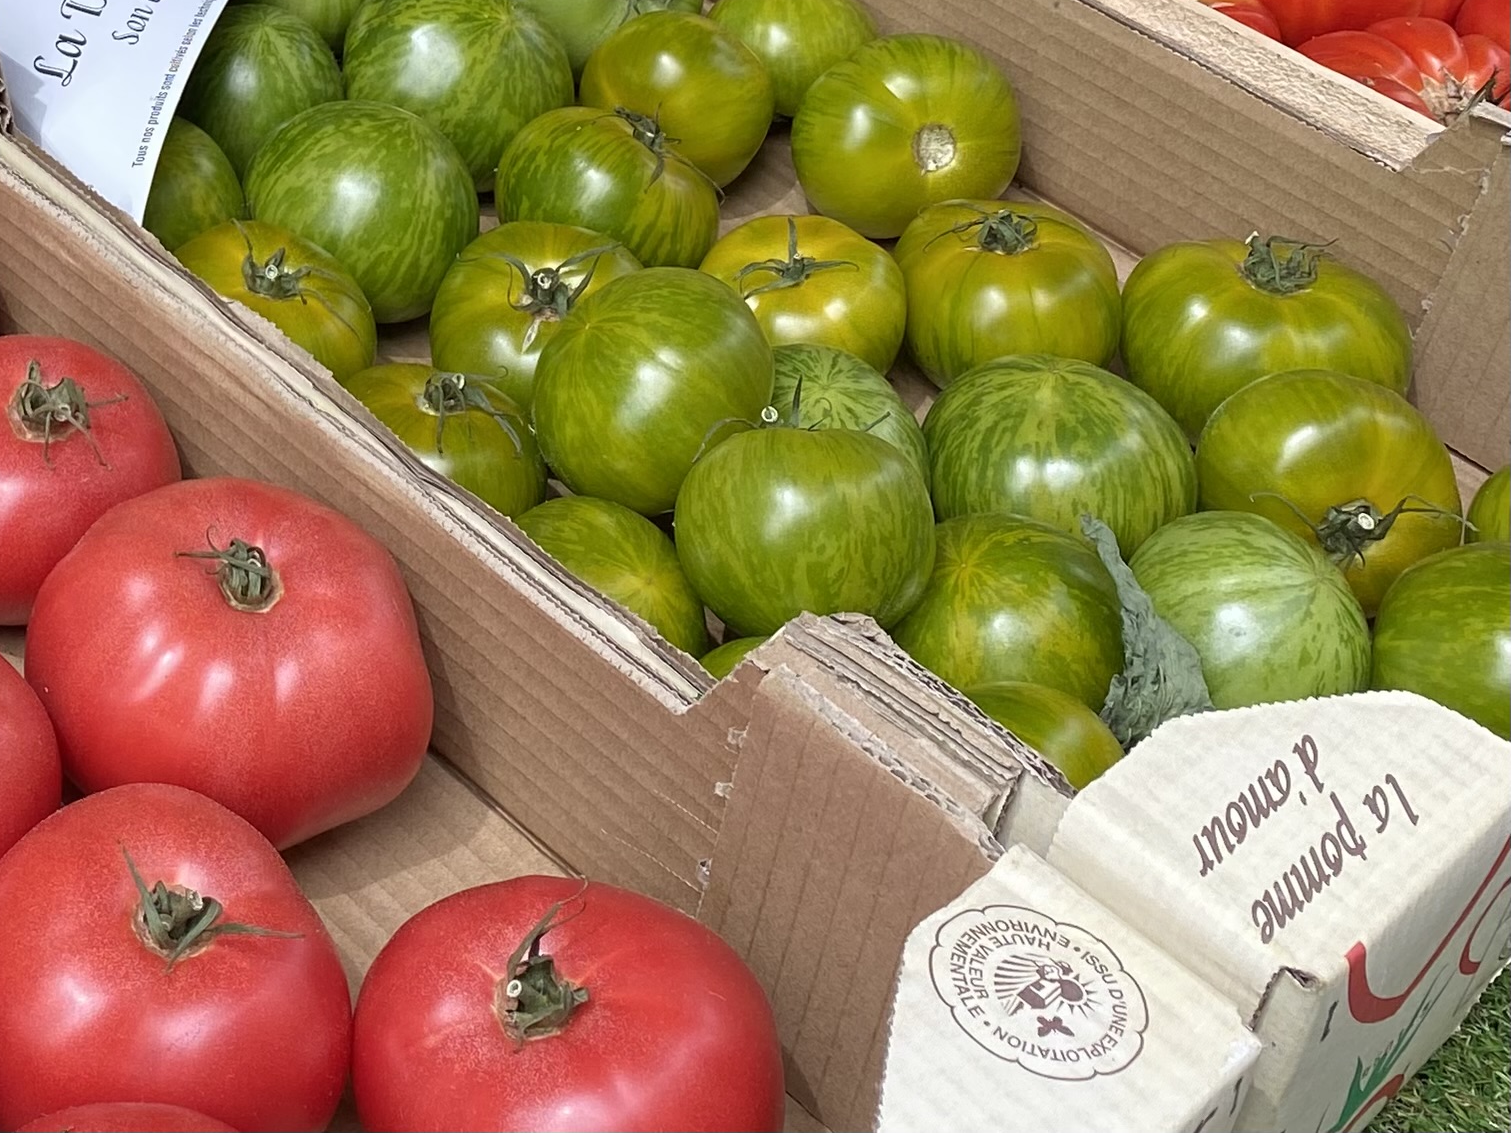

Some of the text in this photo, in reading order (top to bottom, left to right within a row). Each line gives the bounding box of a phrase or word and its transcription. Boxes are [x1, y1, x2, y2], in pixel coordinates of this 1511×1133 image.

[33, 29, 87, 87] La
[112, 5, 154, 45] Son
[131, 146, 148, 168] Tous
[141, 127, 155, 143] nos
[148, 91, 168, 125] produits
[161, 74, 176, 90] sont
[1193, 734, 1324, 877] d'amour
[1252, 773, 1419, 944] la pomme
[950, 919, 1071, 1018] ENVIRONNEMENTALE
[968, 933, 1051, 999] HAUTE VALEUR
[992, 951, 1128, 1063] ISSU D'UNE EXPLOITATION
